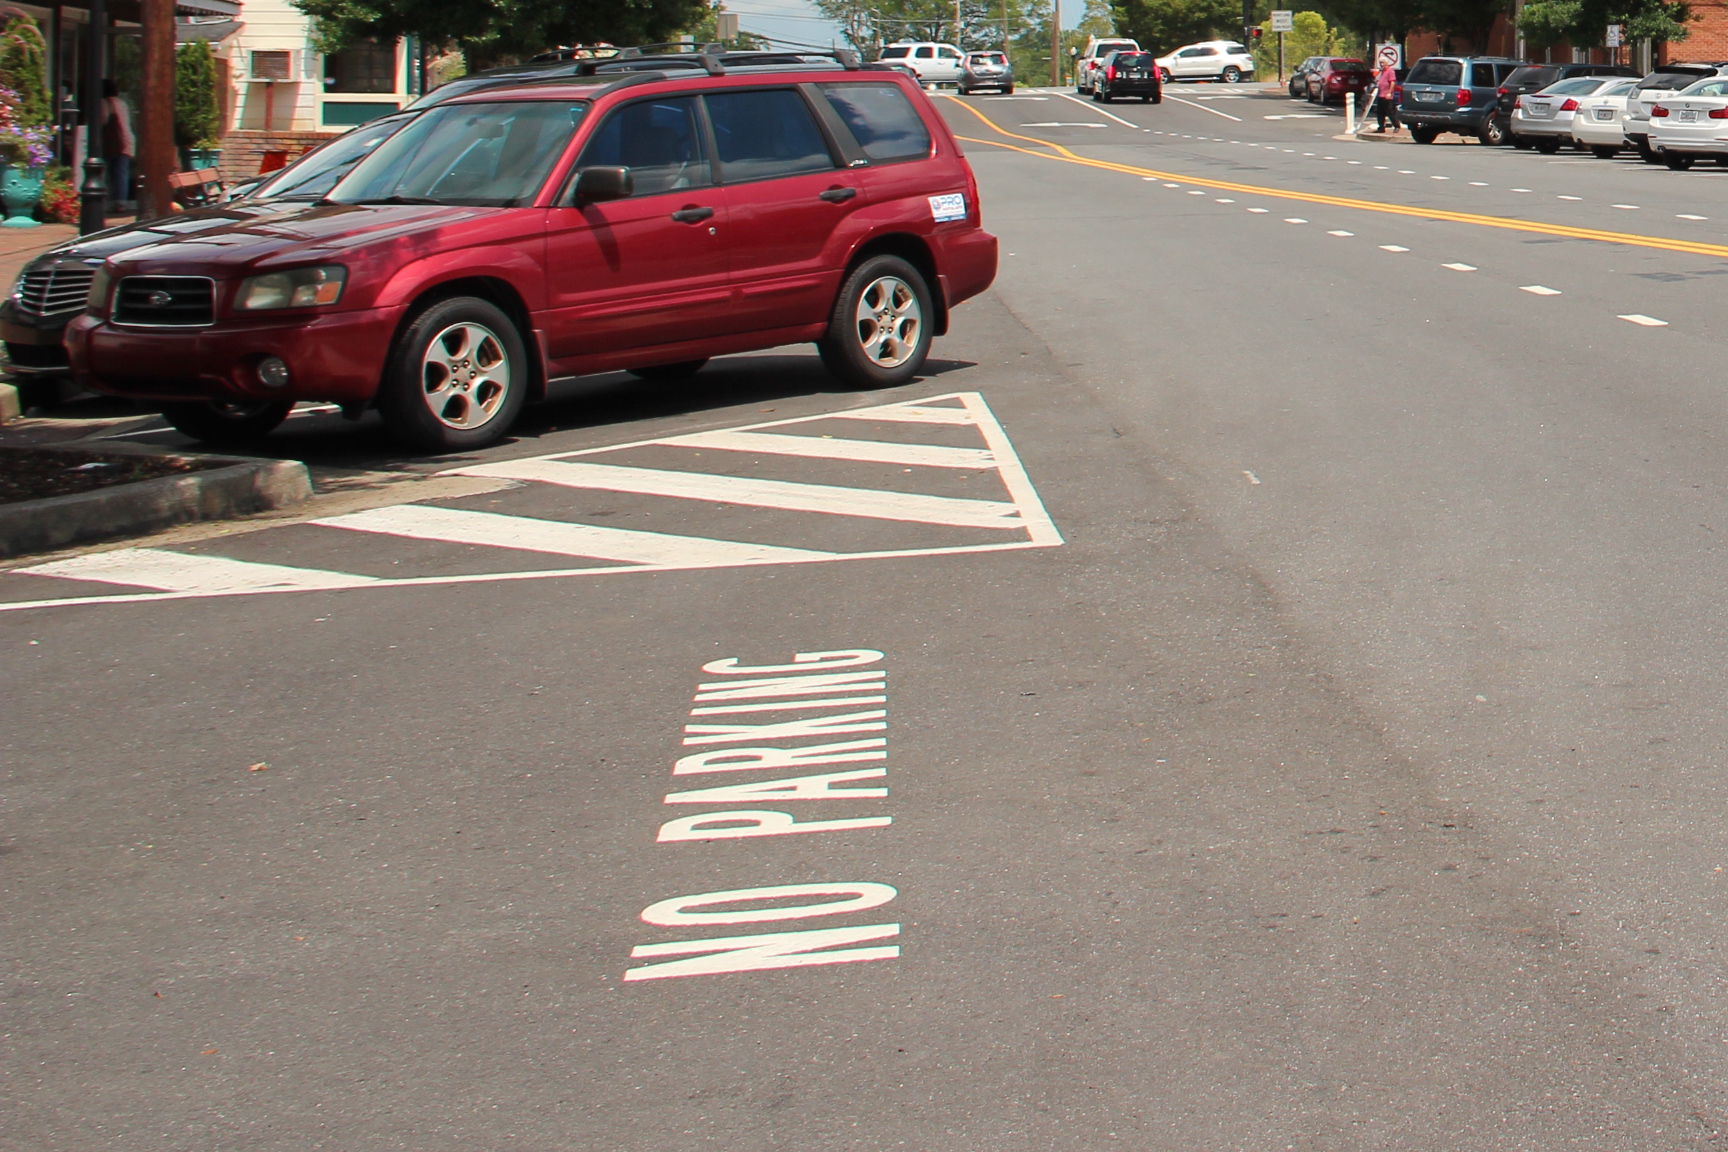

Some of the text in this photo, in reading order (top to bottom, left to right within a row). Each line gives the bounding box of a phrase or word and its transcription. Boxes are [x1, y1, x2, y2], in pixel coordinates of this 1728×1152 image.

[940, 195, 962, 207] PRO
[623, 649, 900, 982] NO PARKING
